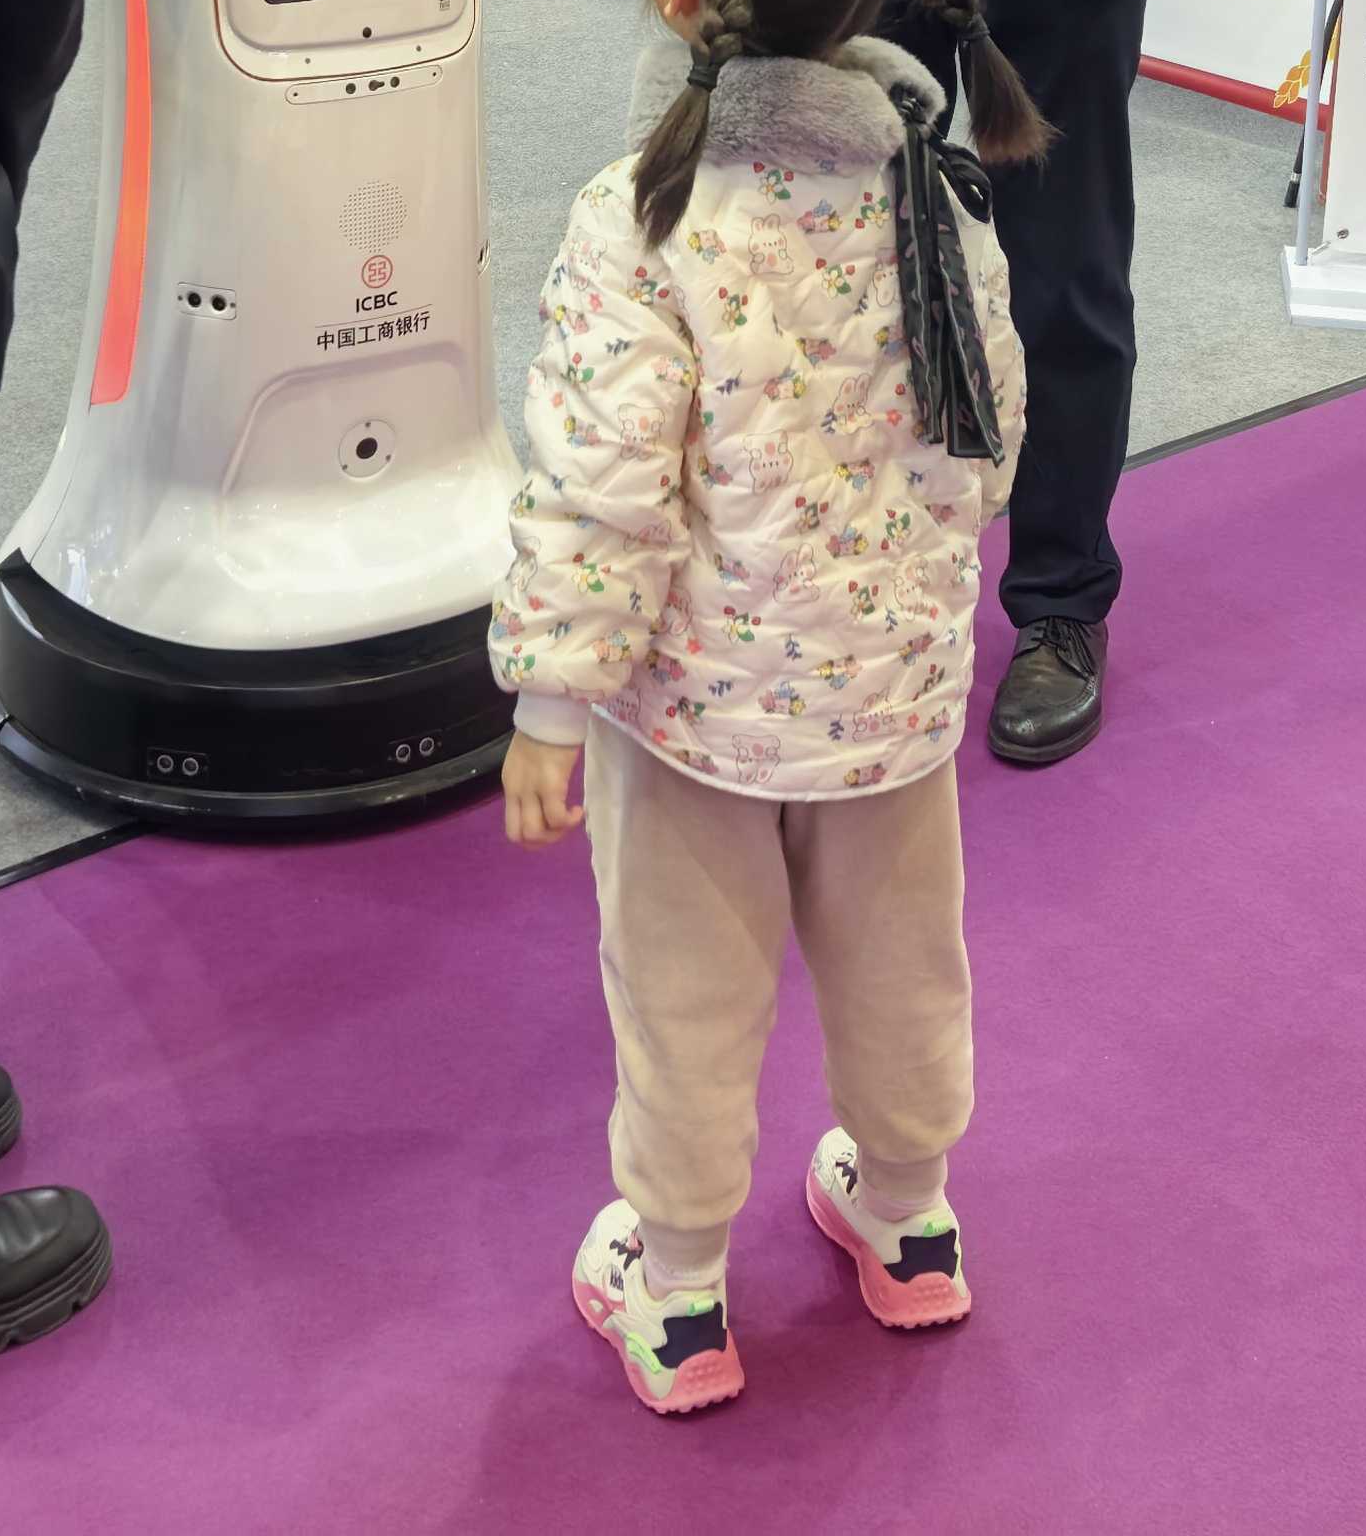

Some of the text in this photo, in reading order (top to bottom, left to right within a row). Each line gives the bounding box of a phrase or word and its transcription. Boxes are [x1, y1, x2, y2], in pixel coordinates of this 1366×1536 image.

[355, 290, 398, 313] ICBC
[316, 310, 432, 351] 中国工商银行
